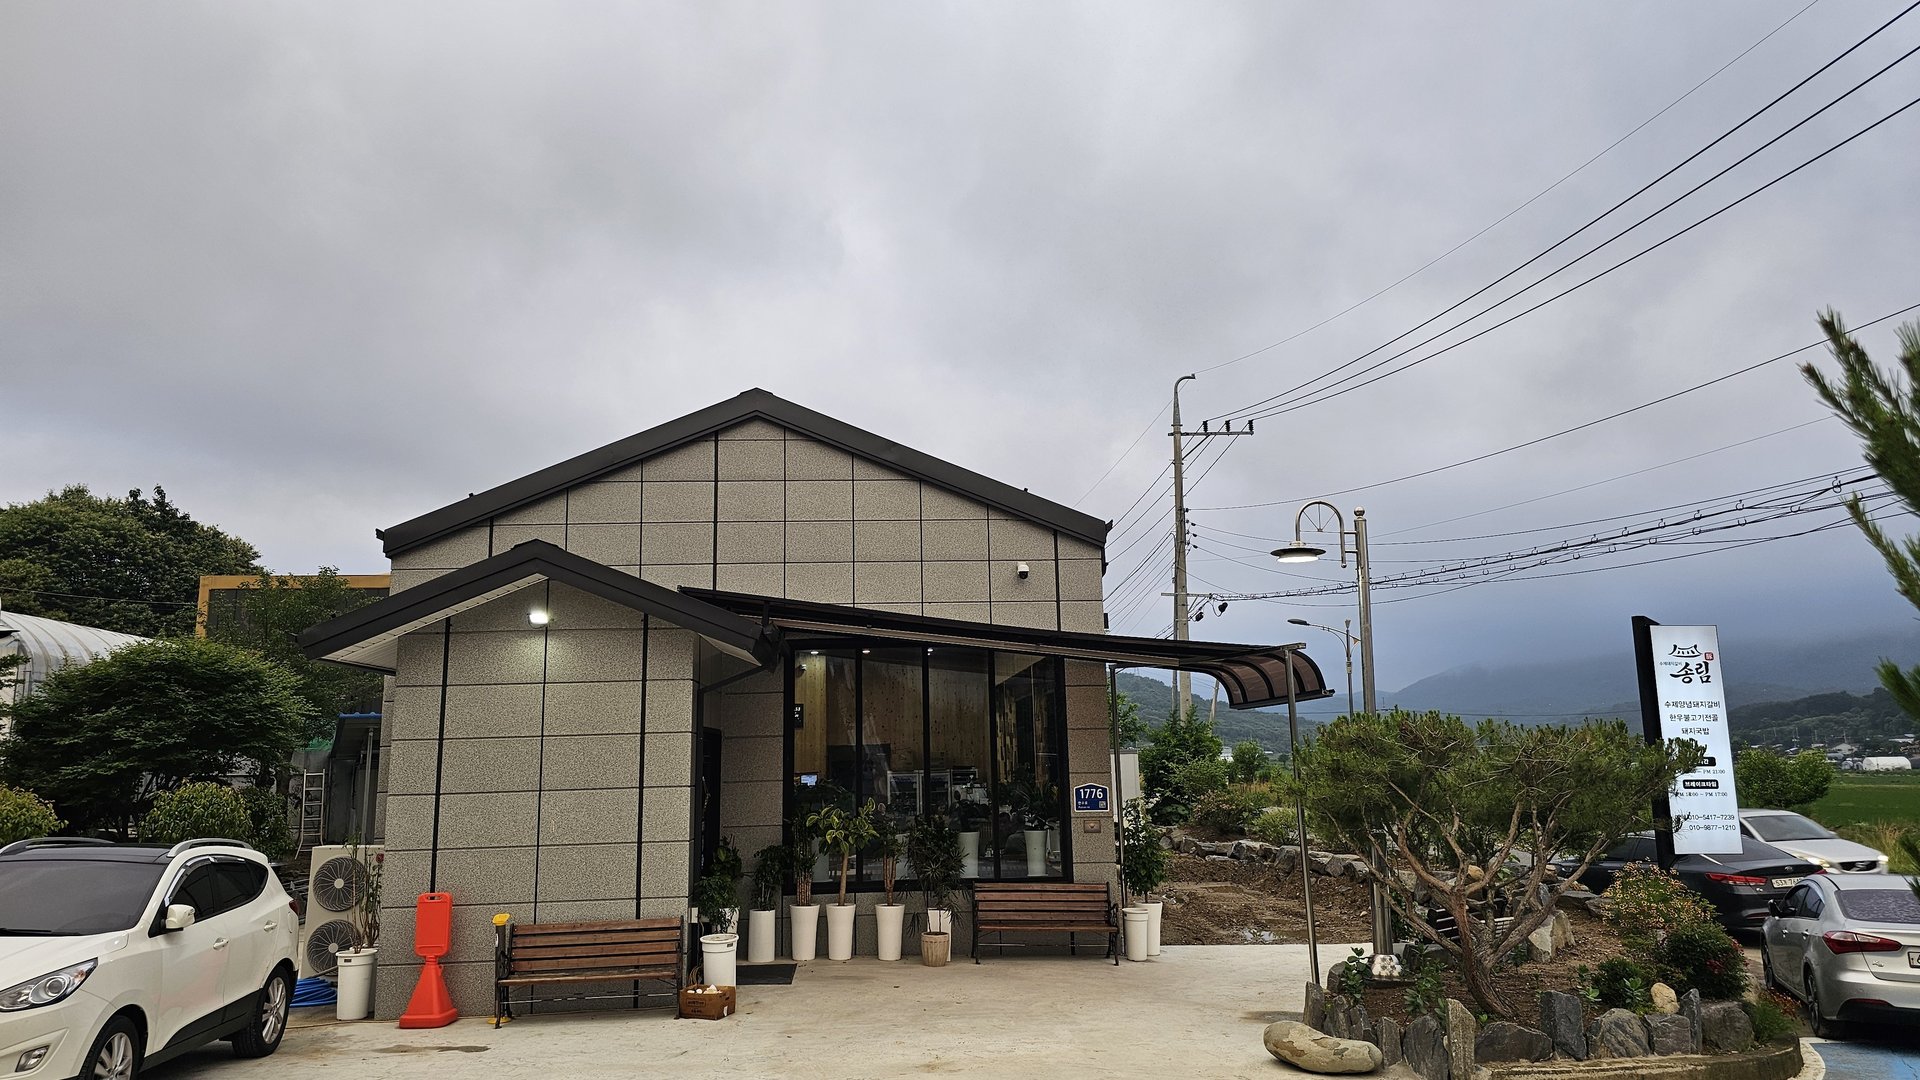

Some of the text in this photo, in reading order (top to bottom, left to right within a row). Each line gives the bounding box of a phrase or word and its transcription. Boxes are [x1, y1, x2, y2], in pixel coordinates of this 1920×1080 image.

[1670, 661, 1711, 684] 송림
[1669, 714, 1718, 722] 한우불고기전골
[1681, 727, 1710, 735] 돼지국밥
[1080, 789, 1103, 799] 1776
